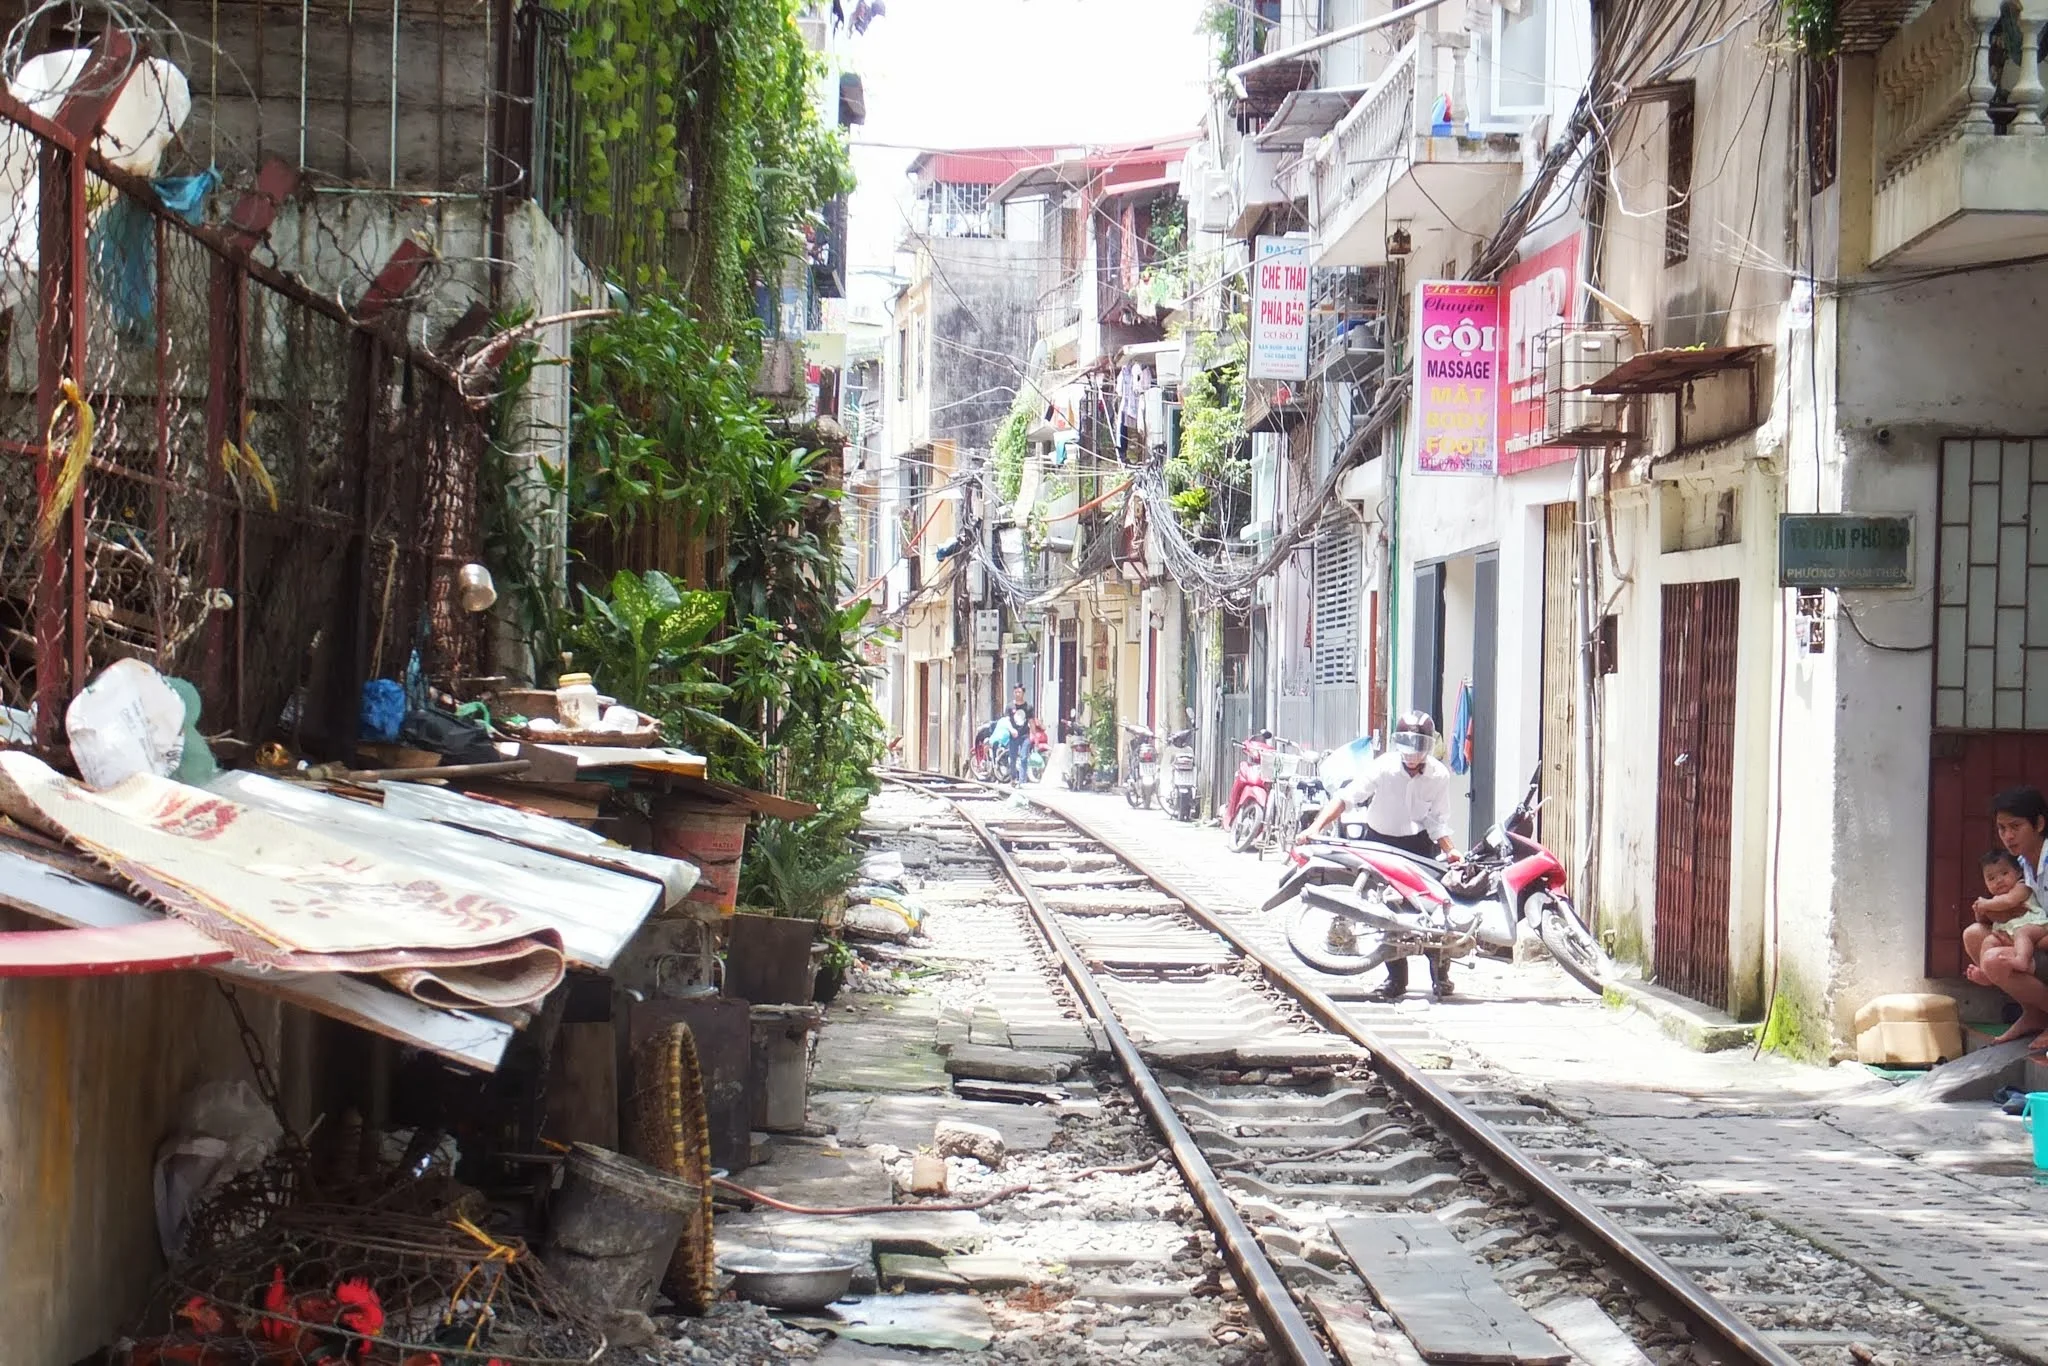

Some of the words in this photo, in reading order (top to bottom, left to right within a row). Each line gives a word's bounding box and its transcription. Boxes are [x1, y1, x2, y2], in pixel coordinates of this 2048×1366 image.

[1262, 260, 1281, 290] CHÈ
[1285, 262, 1306, 290] THÁI
[1261, 296, 1282, 325] PHÍA
[1285, 294, 1305, 326] BẮC
[1424, 297, 1485, 313] Chuyên
[1423, 317, 1496, 358] GỘI
[1427, 360, 1490, 379] MASSAGE
[1427, 412, 1489, 430] BODY
[1426, 435, 1487, 457] FOOT
